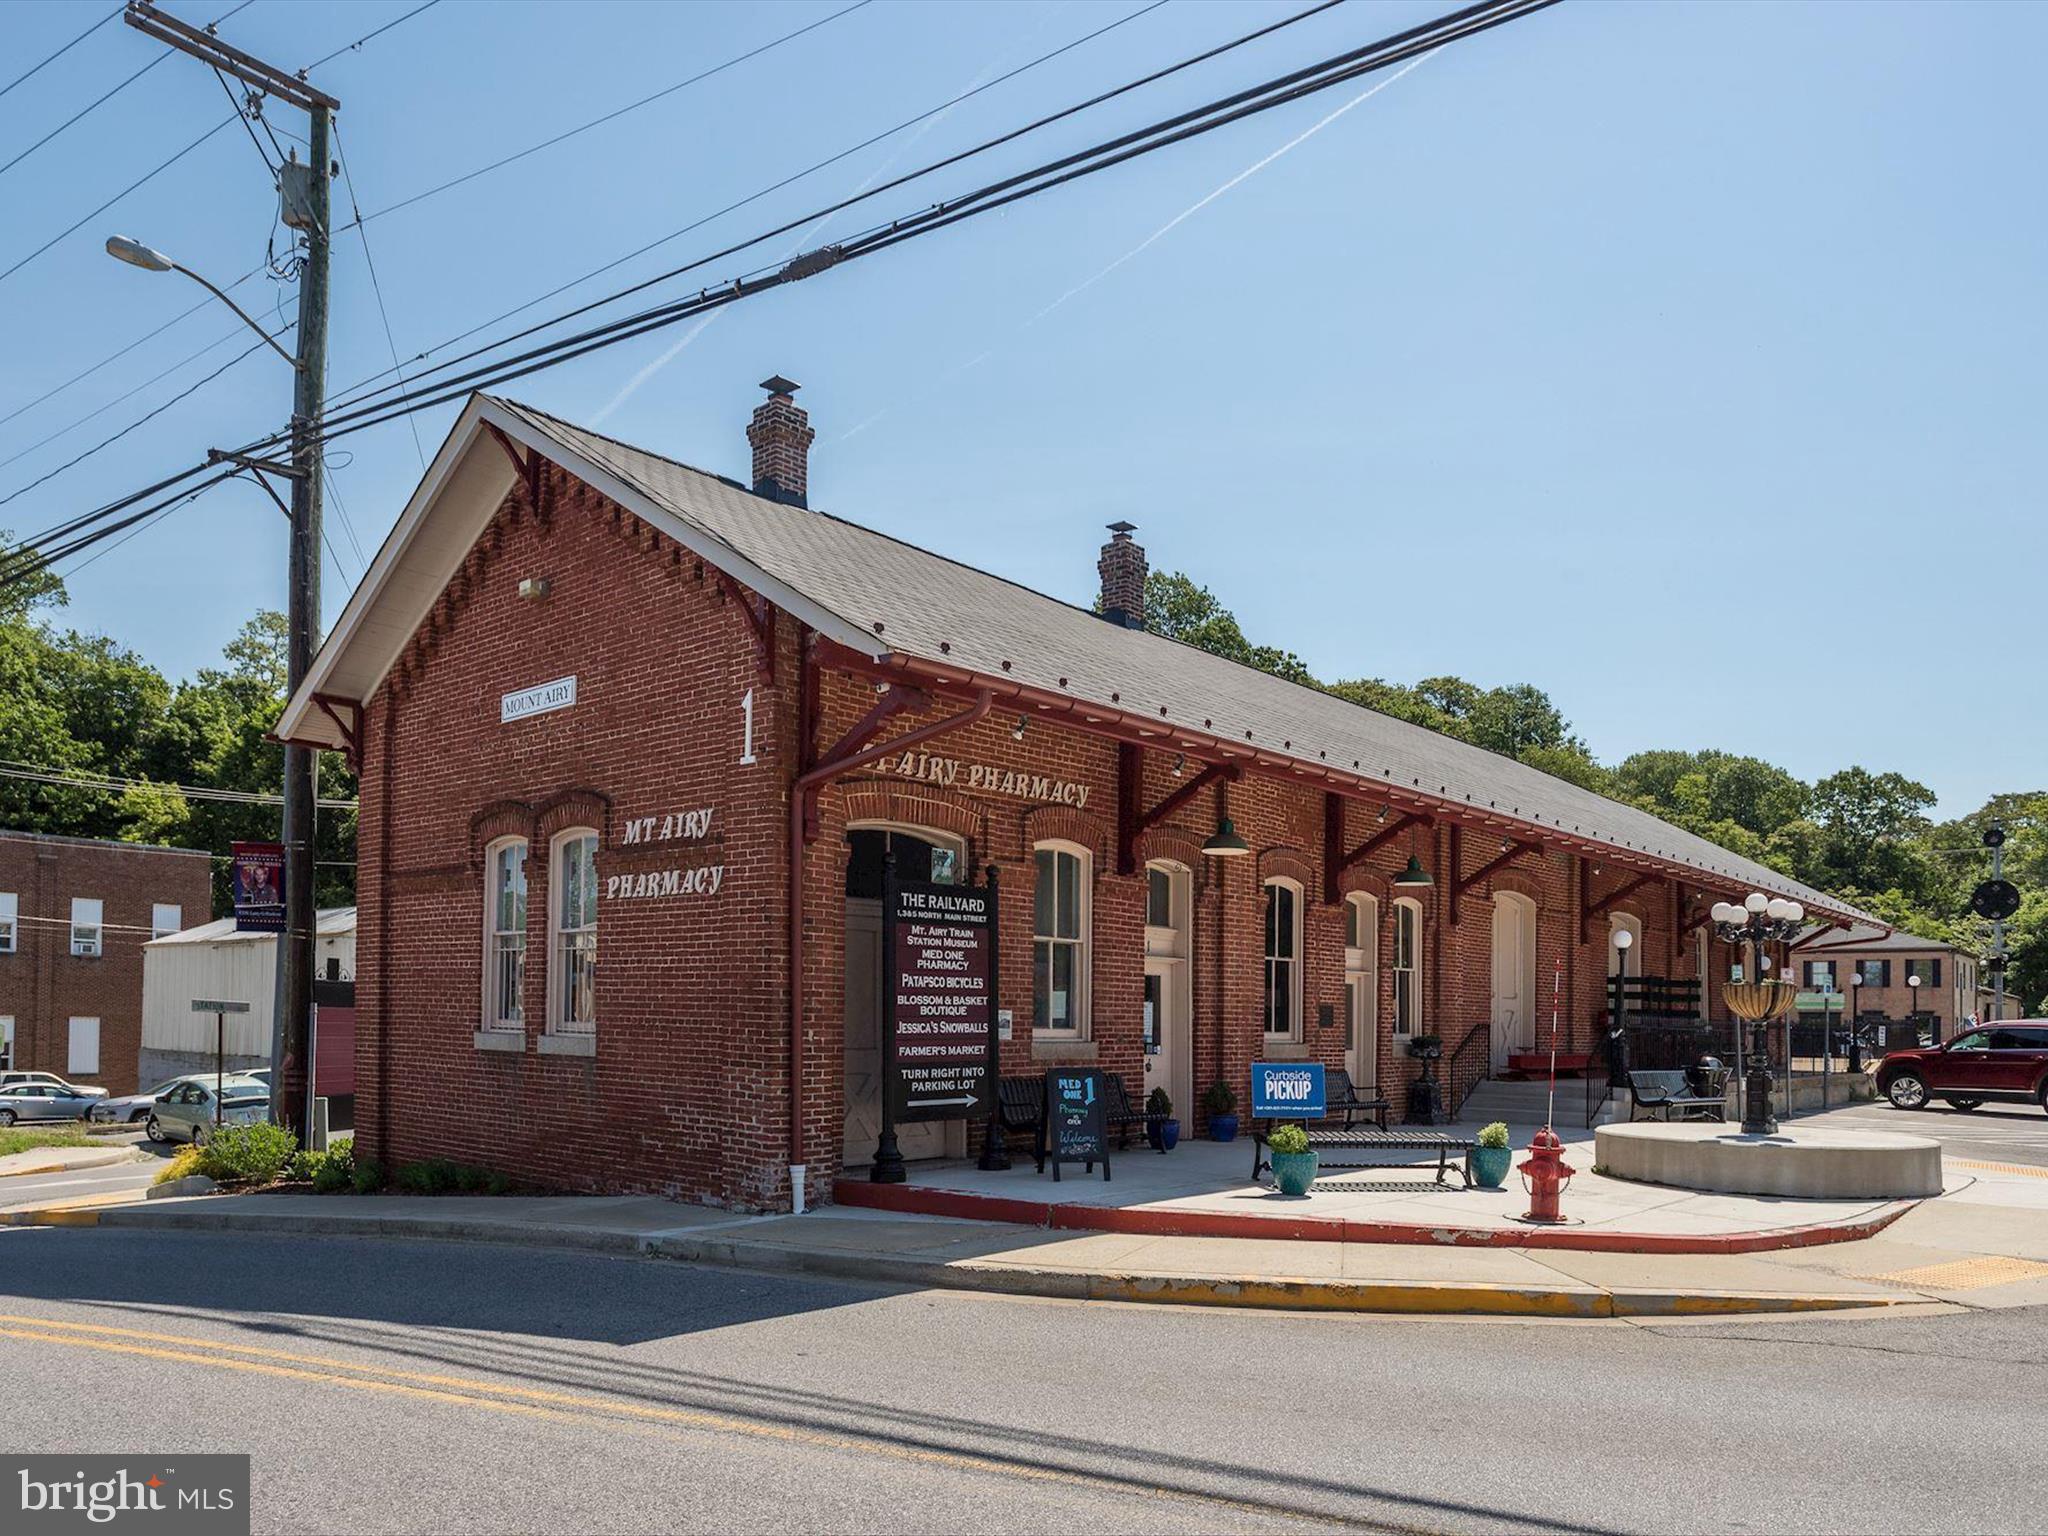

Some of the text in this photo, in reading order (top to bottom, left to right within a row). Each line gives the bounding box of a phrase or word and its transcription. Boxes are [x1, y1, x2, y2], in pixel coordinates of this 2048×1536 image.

[505, 684, 570, 715] MOUNT AIRY
[740, 688, 756, 765] 1
[896, 751, 959, 785] AIRY
[968, 765, 1090, 808] PHARMACY
[623, 808, 714, 845] MT AIRY
[606, 865, 724, 900] PHARMACY
[901, 892, 985, 912] THE RAILYARD
[918, 911, 942, 919] NORTH
[944, 913, 961, 921] MAIN
[962, 914, 987, 923] STREET
[922, 949, 964, 960] MED ONE
[917, 959, 969, 971] PHARMACY
[946, 977, 984, 989] BICYCLES
[897, 995, 988, 1006] BLOSSOM & BASKET
[920, 1006, 967, 1016] BOUTIQUE
[898, 1045, 986, 1056] FARMER'S MARKET
[901, 1067, 985, 1080] TURN RIGHT INTO
[1264, 1070, 1312, 1081] Curbside
[911, 1079, 976, 1092] PARKING LOT
[1265, 1080, 1312, 1100] PICKUP
